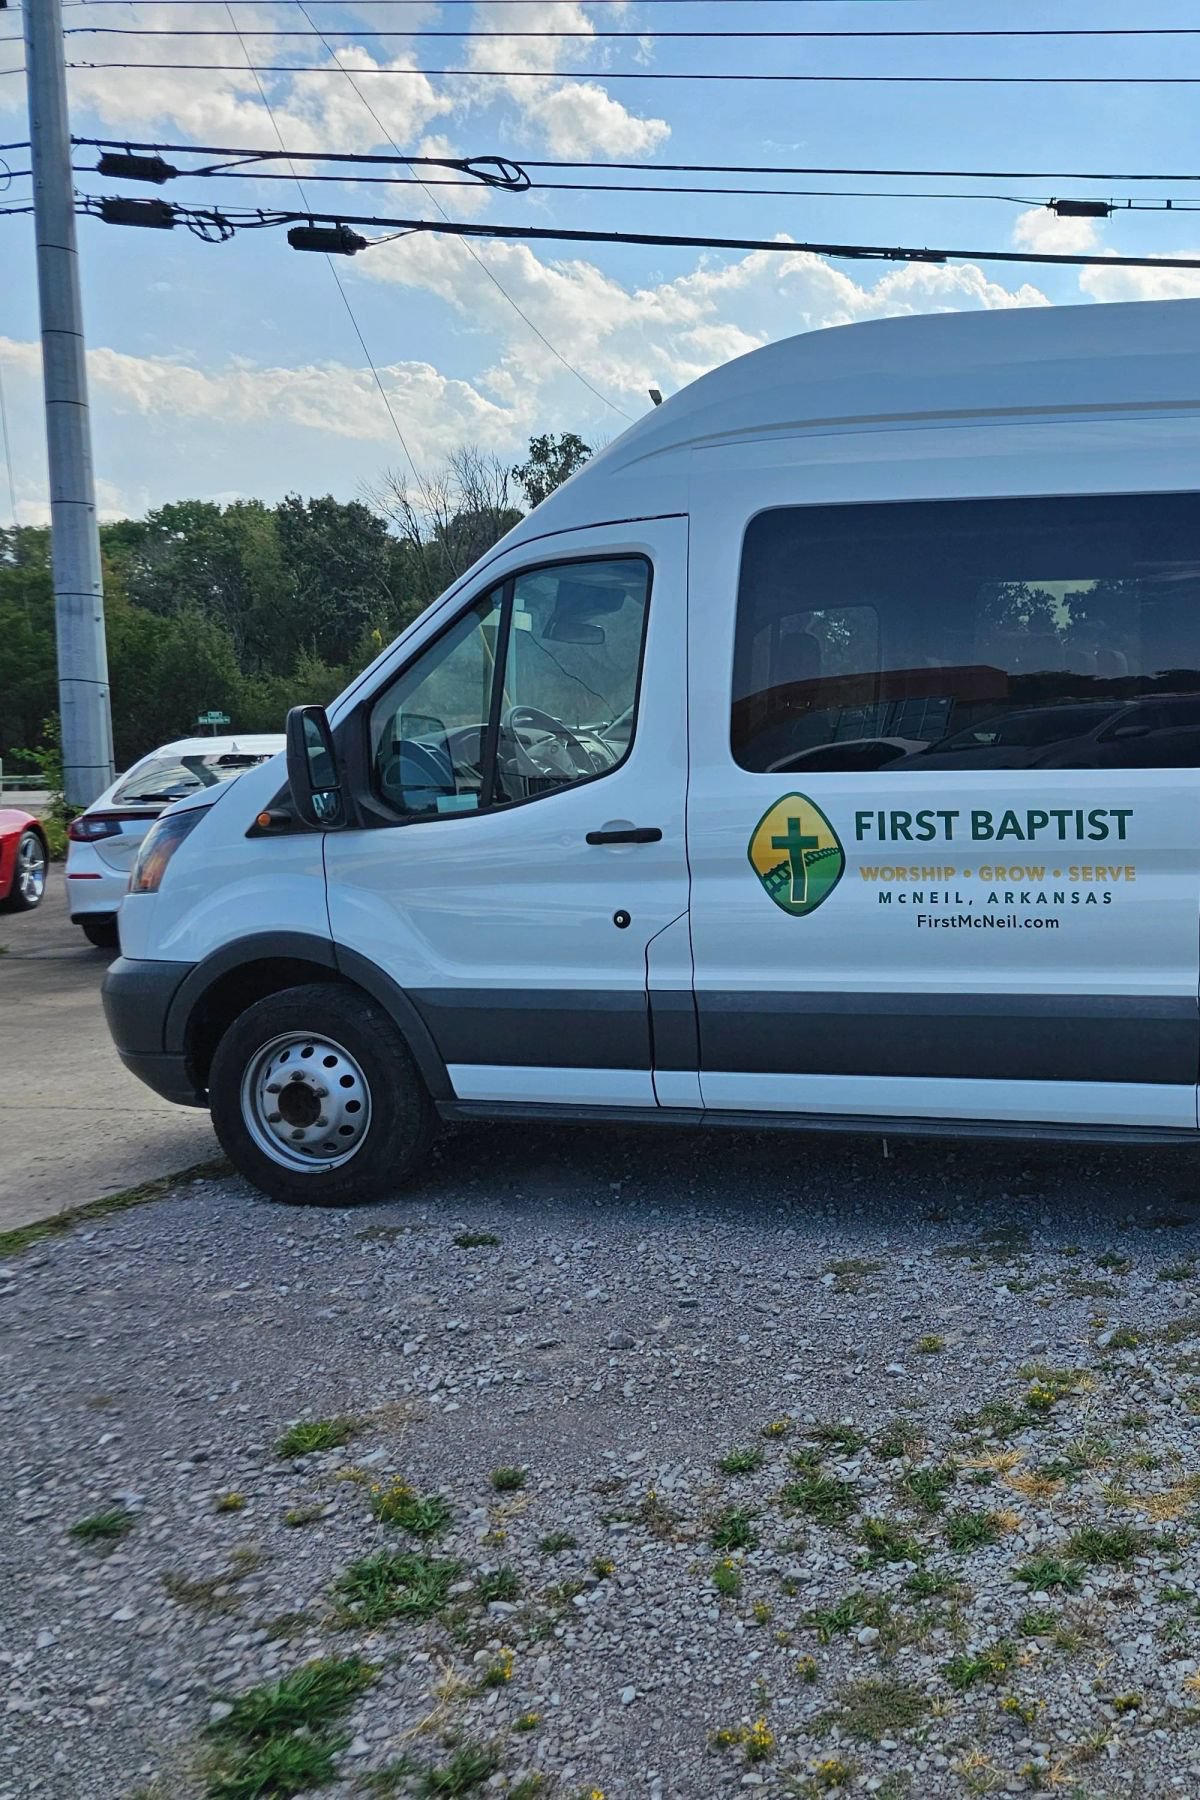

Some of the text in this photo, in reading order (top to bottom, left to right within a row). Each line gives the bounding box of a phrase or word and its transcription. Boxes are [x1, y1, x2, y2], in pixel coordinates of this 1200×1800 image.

[855, 809, 1133, 841] FIRST BAPTIST
[859, 865, 1137, 882] WORSHIP GROW SERVE
[878, 891, 1113, 906] McNEIL, ARKANSAS
[917, 914, 1060, 928] FirstMcNeil.com
